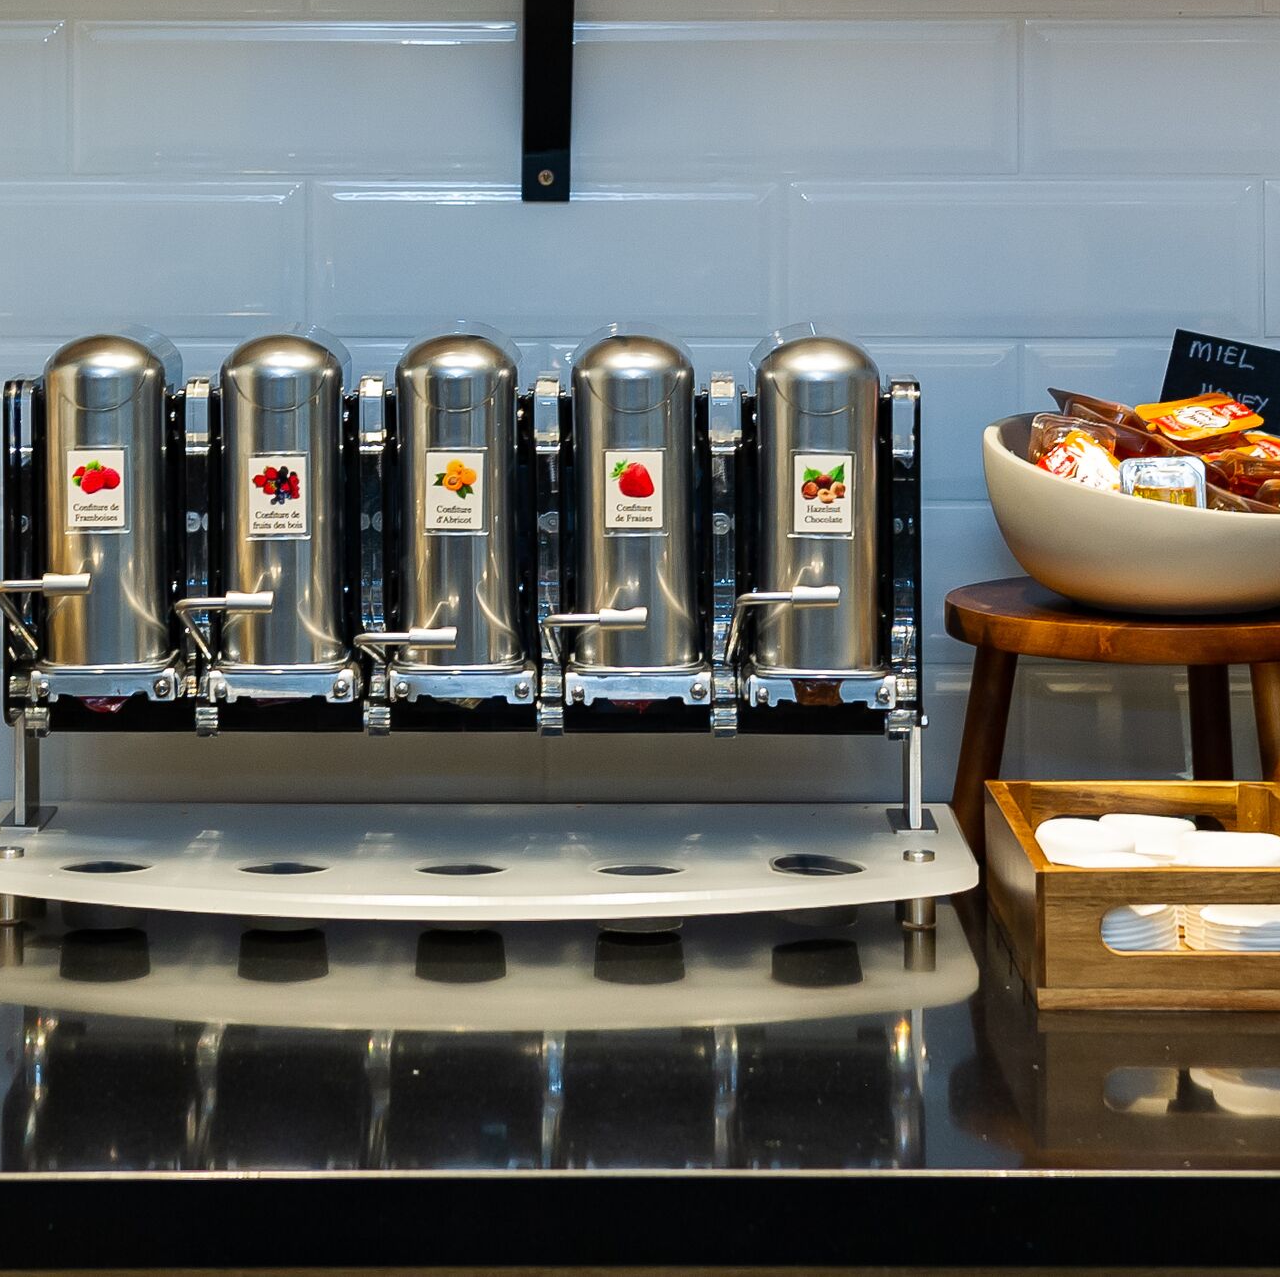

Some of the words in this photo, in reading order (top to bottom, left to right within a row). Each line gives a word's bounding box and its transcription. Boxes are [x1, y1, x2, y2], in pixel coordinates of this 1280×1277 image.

[1189, 340, 1255, 370] MIEL
[73, 503, 108, 512] Confiture
[109, 503, 120, 511] de
[436, 505, 472, 514] Confiture
[616, 503, 652, 512] Confiture
[807, 505, 841, 513] Hazelnut
[74, 513, 118, 522] Framboises
[255, 510, 290, 519] Confiture
[291, 510, 300, 519] de
[614, 513, 625, 522] de
[626, 513, 654, 522] Fraises
[804, 515, 843, 523] Chocolate
[436, 515, 472, 524] d'Abricot
[253, 520, 271, 529] fruits
[273, 520, 286, 529] des
[287, 520, 303, 529] bois
